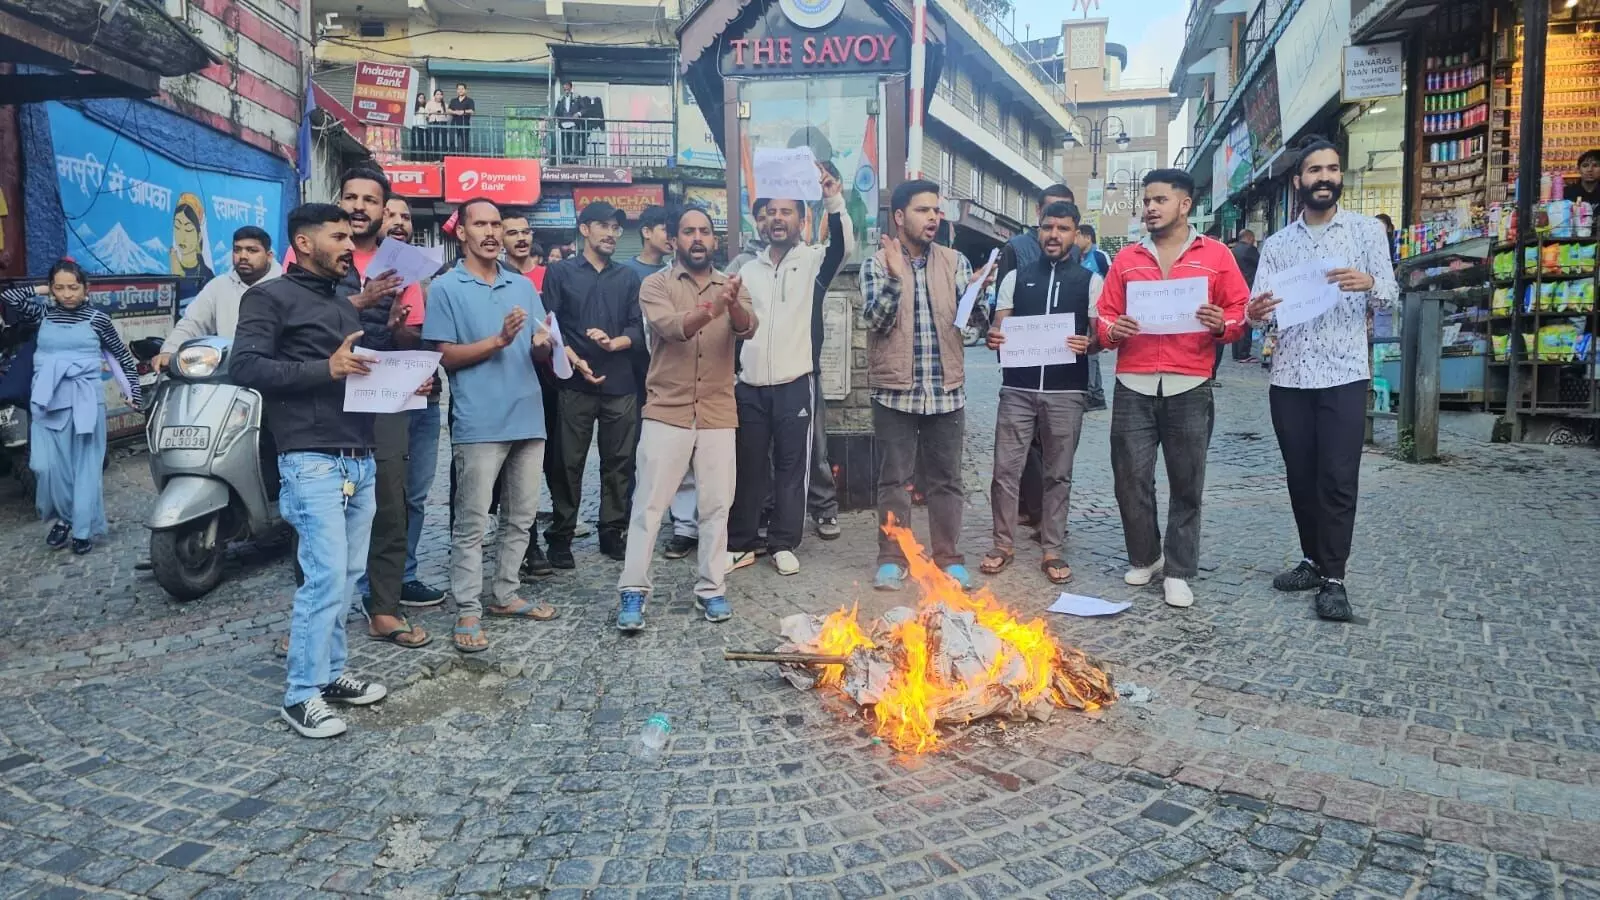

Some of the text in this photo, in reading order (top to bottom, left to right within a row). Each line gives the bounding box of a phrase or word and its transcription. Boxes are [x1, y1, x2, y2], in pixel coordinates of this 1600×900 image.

[730, 33, 896, 65] THE SAVOY
[1353, 57, 1392, 67] BANARAS
[1347, 64, 1400, 76] PAAN HOUSE
[376, 76, 402, 87] Bank
[357, 87, 368, 95] 24
[385, 89, 406, 100] ATM
[481, 172, 527, 182] Payments
[481, 182, 505, 191] Bank
[128, 176, 172, 213] आपका
[212, 194, 250, 224] स्वागत
[1102, 200, 1144, 217] MOSAI
[115, 285, 156, 309] पुलिस
[172, 427, 200, 437] UK07
